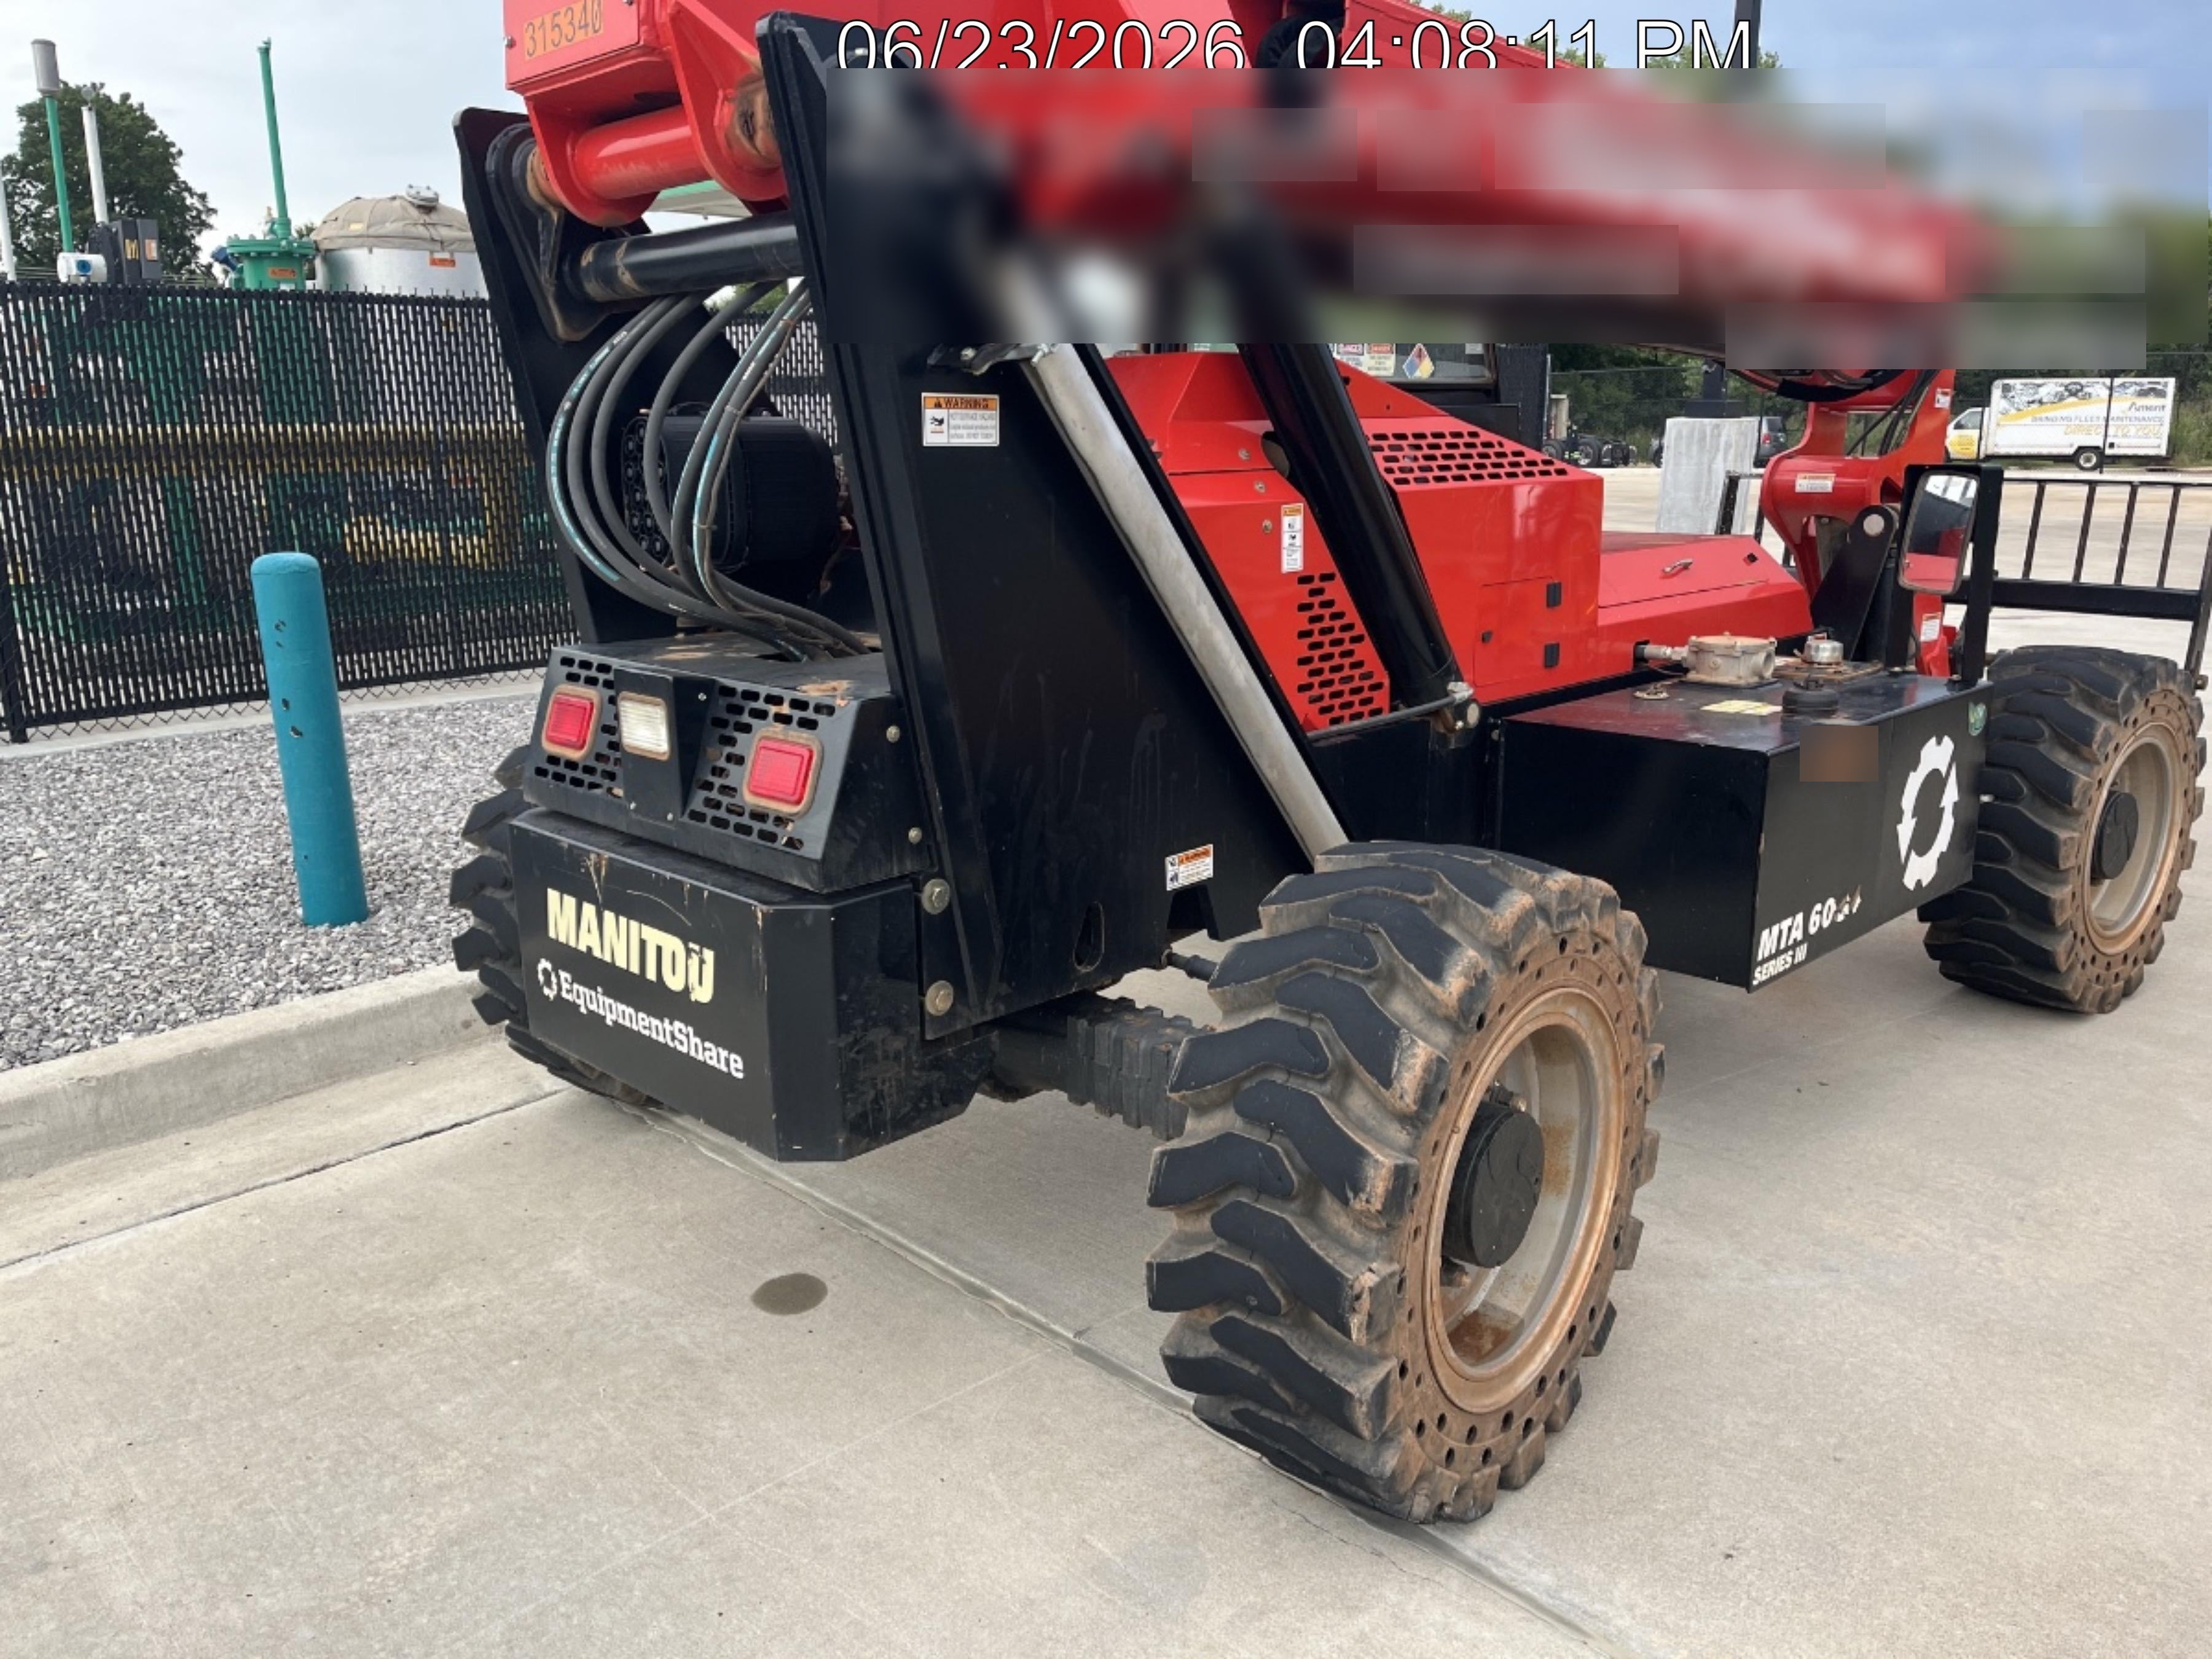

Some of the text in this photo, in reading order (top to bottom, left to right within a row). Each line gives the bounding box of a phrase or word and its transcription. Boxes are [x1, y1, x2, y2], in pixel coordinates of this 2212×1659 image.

[525, 0, 602, 57] 315340
[944, 398, 989, 409] WARNING
[2065, 424, 2105, 436] DIREC
[547, 888, 715, 1003] MANITOU
[1757, 912, 1804, 962] MTA
[1752, 951, 1794, 985] SERIES
[559, 969, 745, 1079] EquipmentShare
